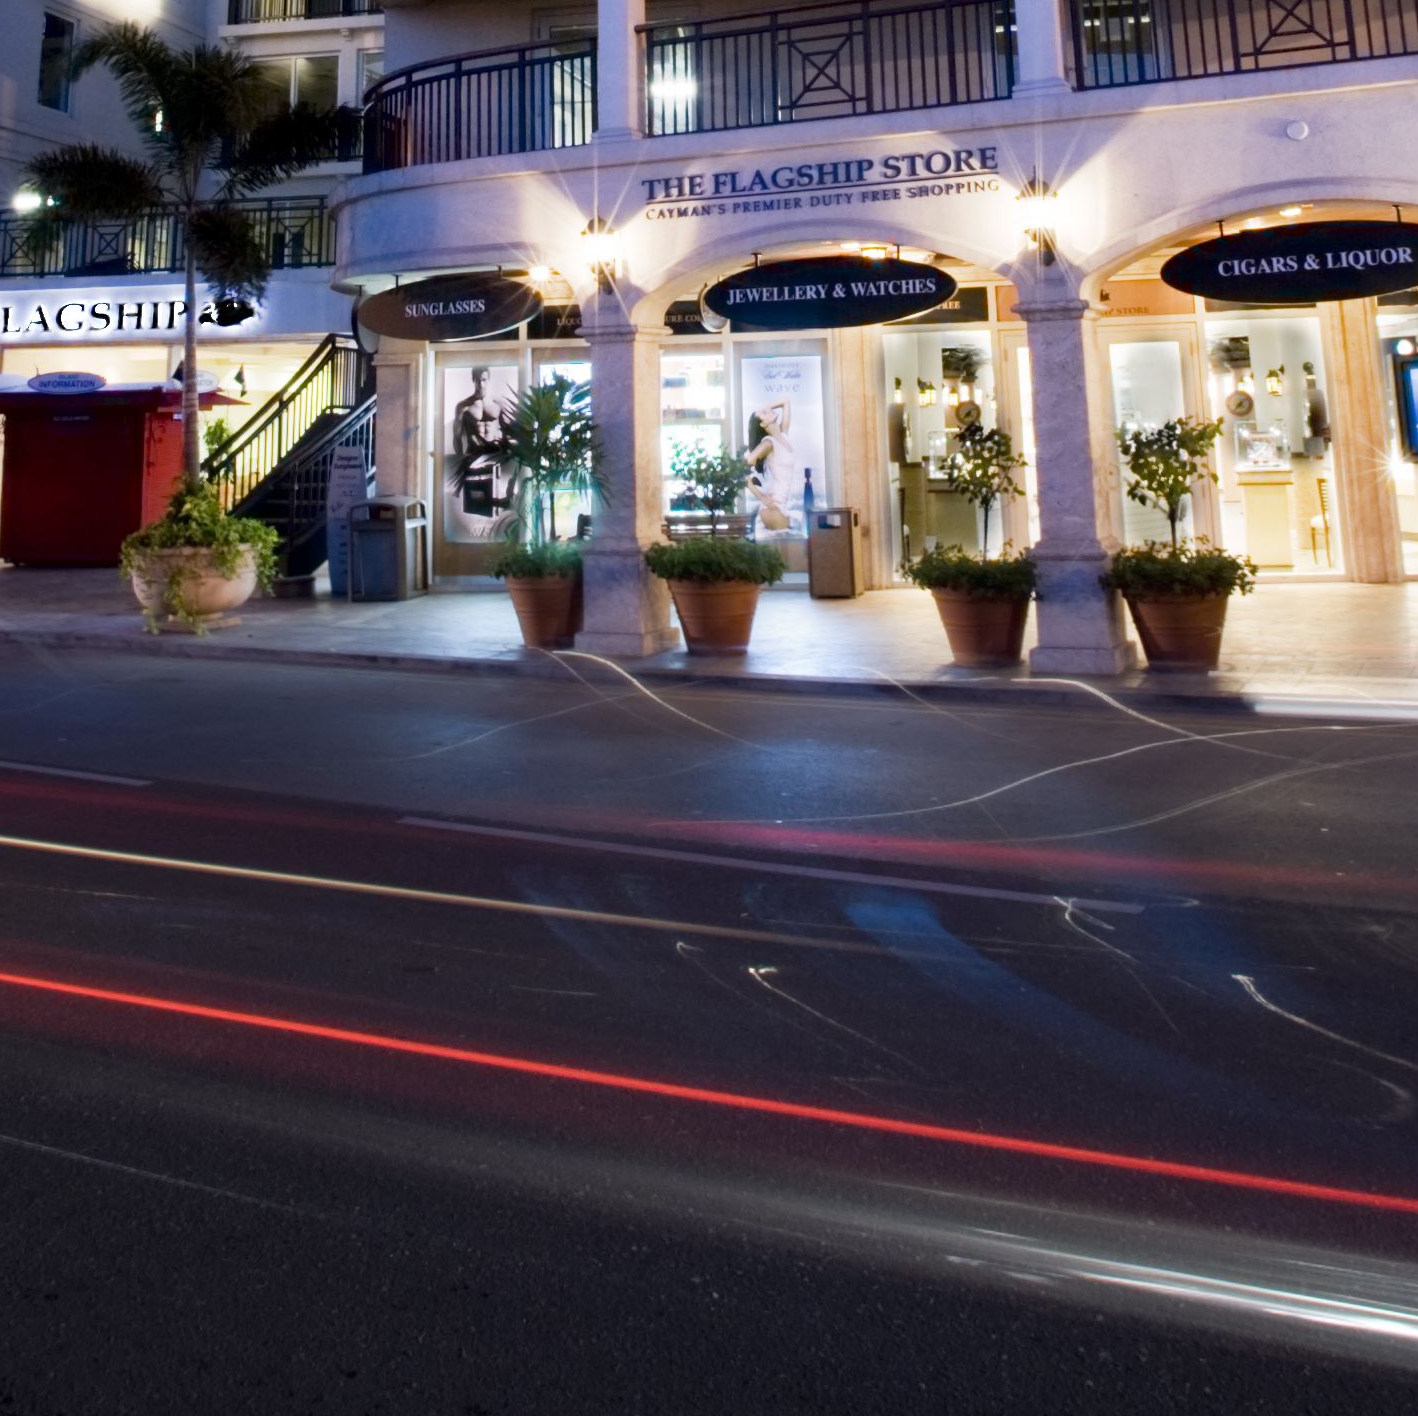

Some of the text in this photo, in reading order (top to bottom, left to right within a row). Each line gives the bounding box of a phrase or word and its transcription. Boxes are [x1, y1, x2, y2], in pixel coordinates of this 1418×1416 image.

[642, 146, 999, 201] THE FLAGSHIP STORE
[732, 198, 803, 214] PREMIER
[809, 192, 854, 209] DUTY
[861, 188, 902, 203] FREE
[908, 179, 1000, 199] SHOPPING
[1217, 246, 1415, 277] CIGARS & LIQUOR
[726, 277, 937, 305] JEWELLERY & WATCHES
[404, 299, 486, 318] SUNGLASSES
[38, 379, 96, 389] INFORMATION
